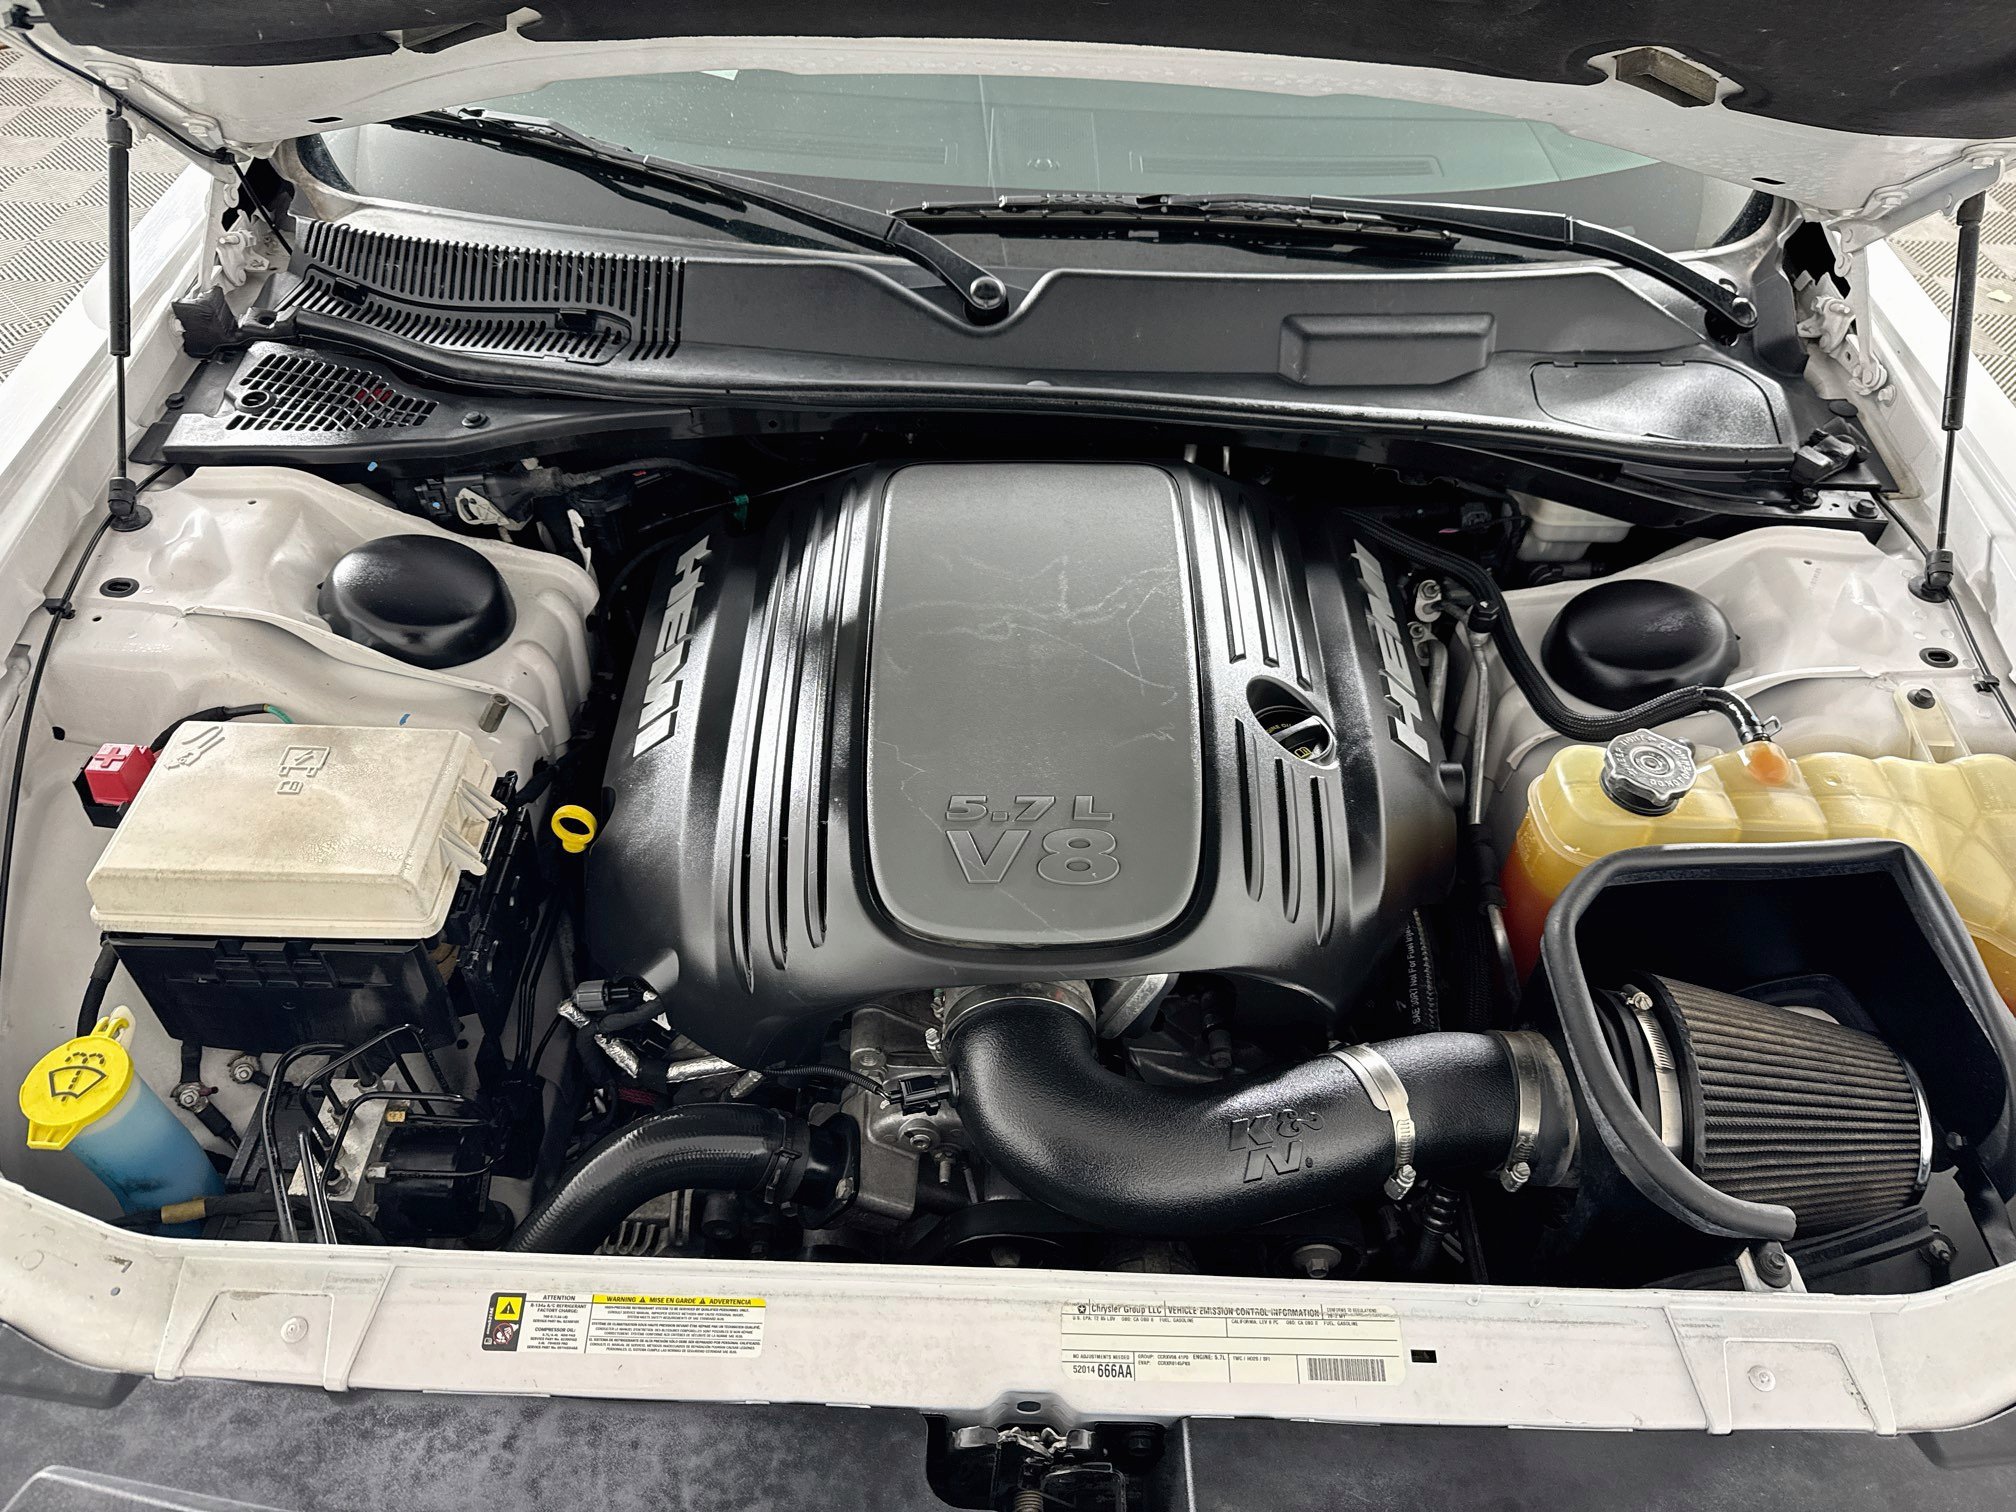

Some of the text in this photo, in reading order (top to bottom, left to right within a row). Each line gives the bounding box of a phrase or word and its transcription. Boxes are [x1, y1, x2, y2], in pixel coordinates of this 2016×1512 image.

[632, 534, 712, 759] HEMI
[1351, 539, 1431, 764] HEMI
[945, 794, 1115, 822] 5.7 L
[944, 827, 1121, 886] V8
[1411, 1007, 1421, 1025] SAE
[1091, 1304, 1162, 1315] Chrysler Group LLC
[1167, 1305, 1320, 1318] VEHICLE EMISSION CONTROL INFORMATION
[1072, 1363, 1133, 1379] 52014 666AA
